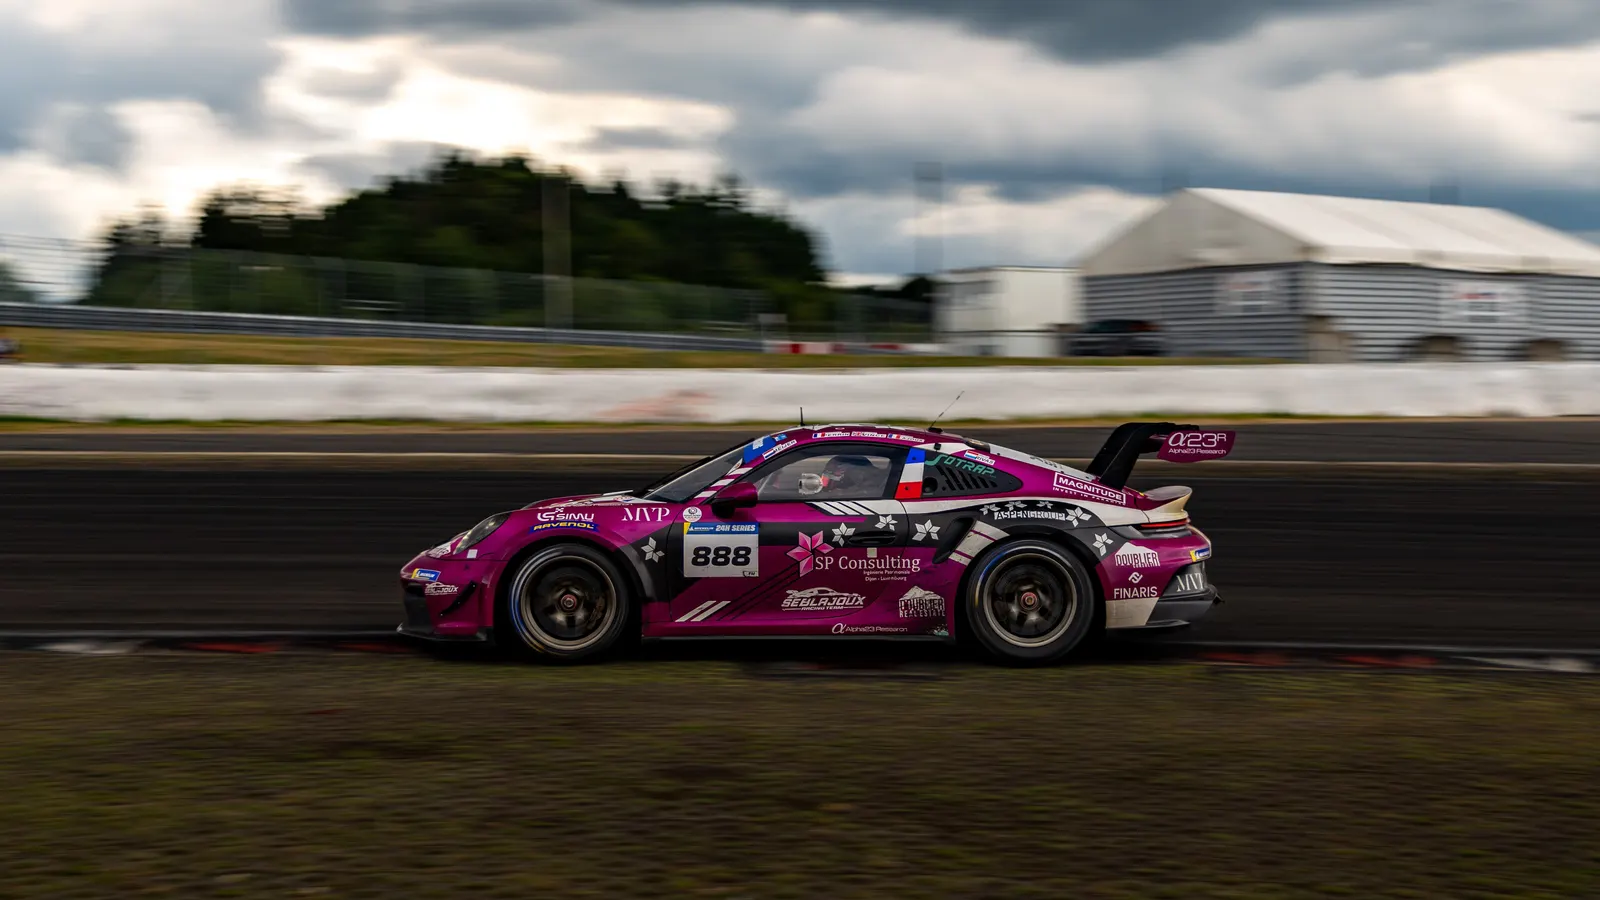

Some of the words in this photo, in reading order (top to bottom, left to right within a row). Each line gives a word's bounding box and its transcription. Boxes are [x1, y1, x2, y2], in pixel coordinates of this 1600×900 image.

[1058, 476, 1122, 501] MAGNITUDE
[621, 507, 671, 522] MVP
[533, 521, 596, 531] RAVENOL
[715, 524, 731, 532] 24H
[731, 524, 756, 532] SERIES
[691, 546, 752, 567] 888
[815, 556, 834, 570] SP
[838, 555, 921, 572] Consulting
[1115, 552, 1159, 566] DOUBLIER
[1113, 586, 1158, 599] FINARIS
[781, 596, 866, 607] SEBLAJOUX
